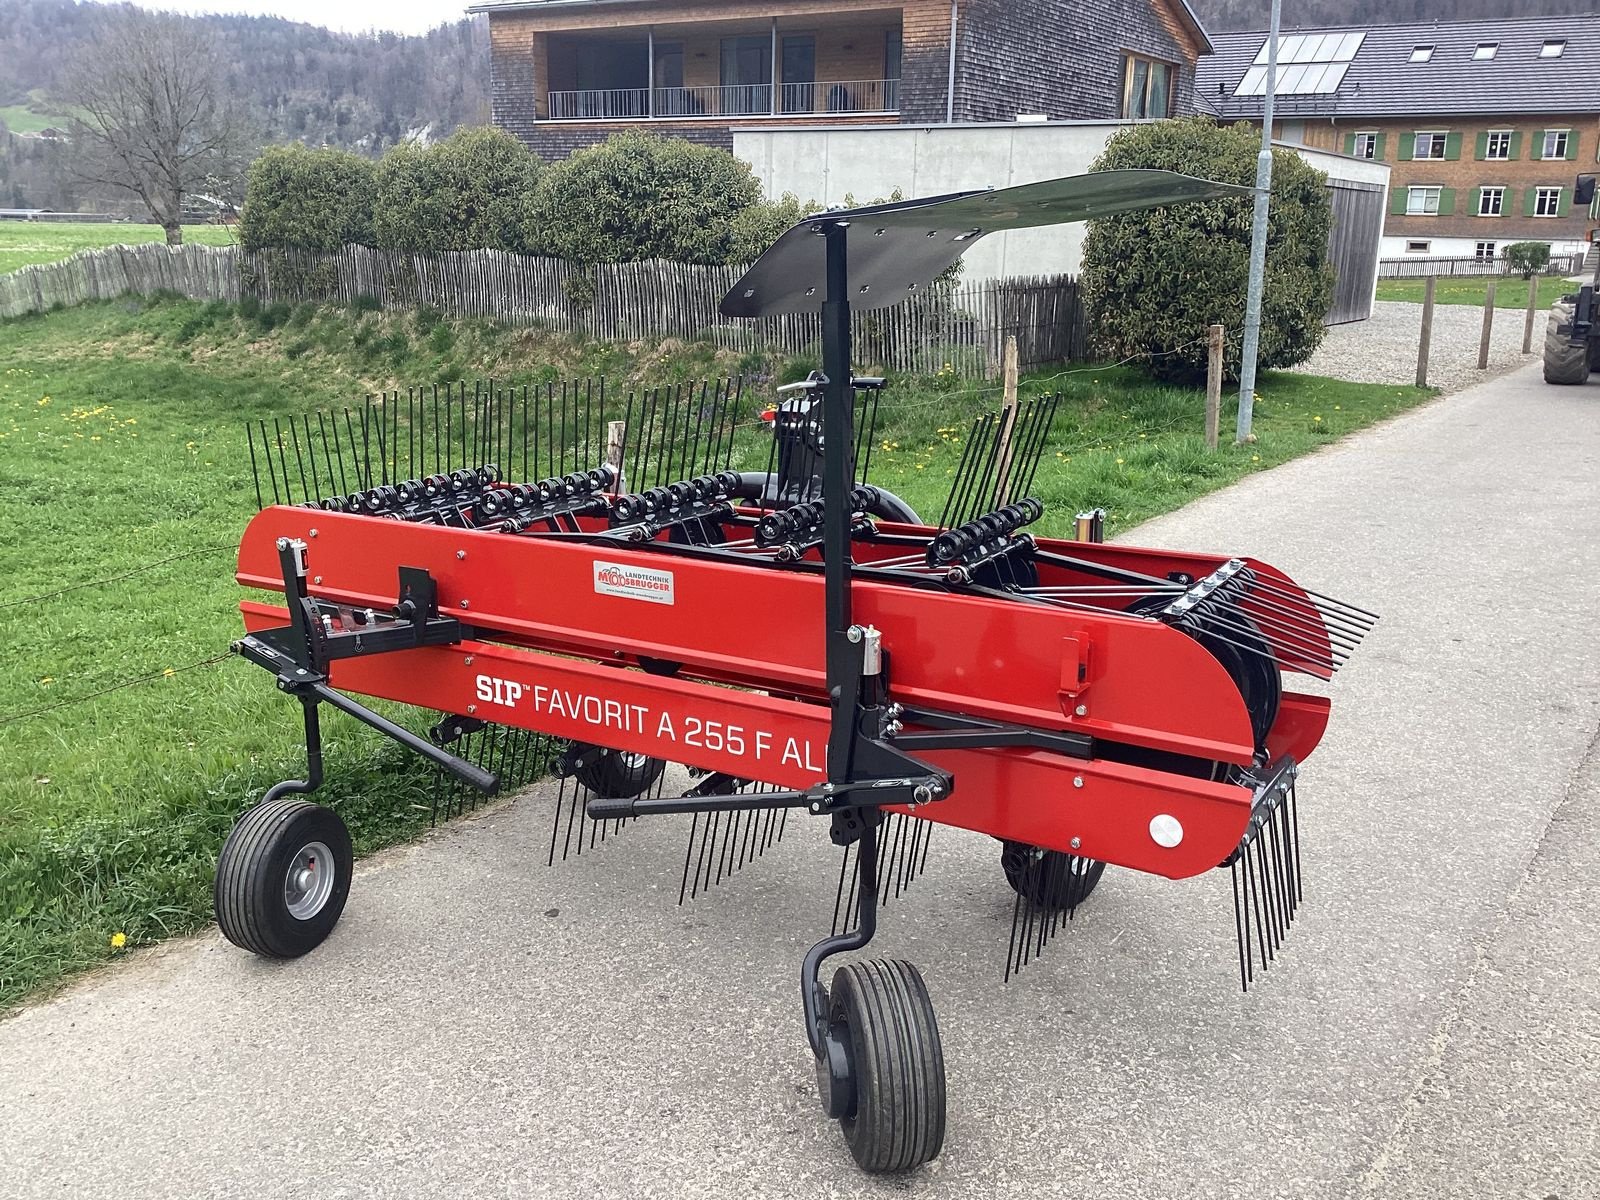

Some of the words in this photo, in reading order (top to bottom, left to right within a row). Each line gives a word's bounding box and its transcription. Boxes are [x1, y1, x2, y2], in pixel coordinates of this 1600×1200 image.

[625, 571, 669, 584] LANDTECHNIK
[310, 606, 317, 614] 2
[534, 685, 649, 734] FAVORIT
[656, 711, 676, 742] A
[684, 717, 745, 756] 255
[755, 730, 773, 760] F
[781, 737, 829, 774] AL
